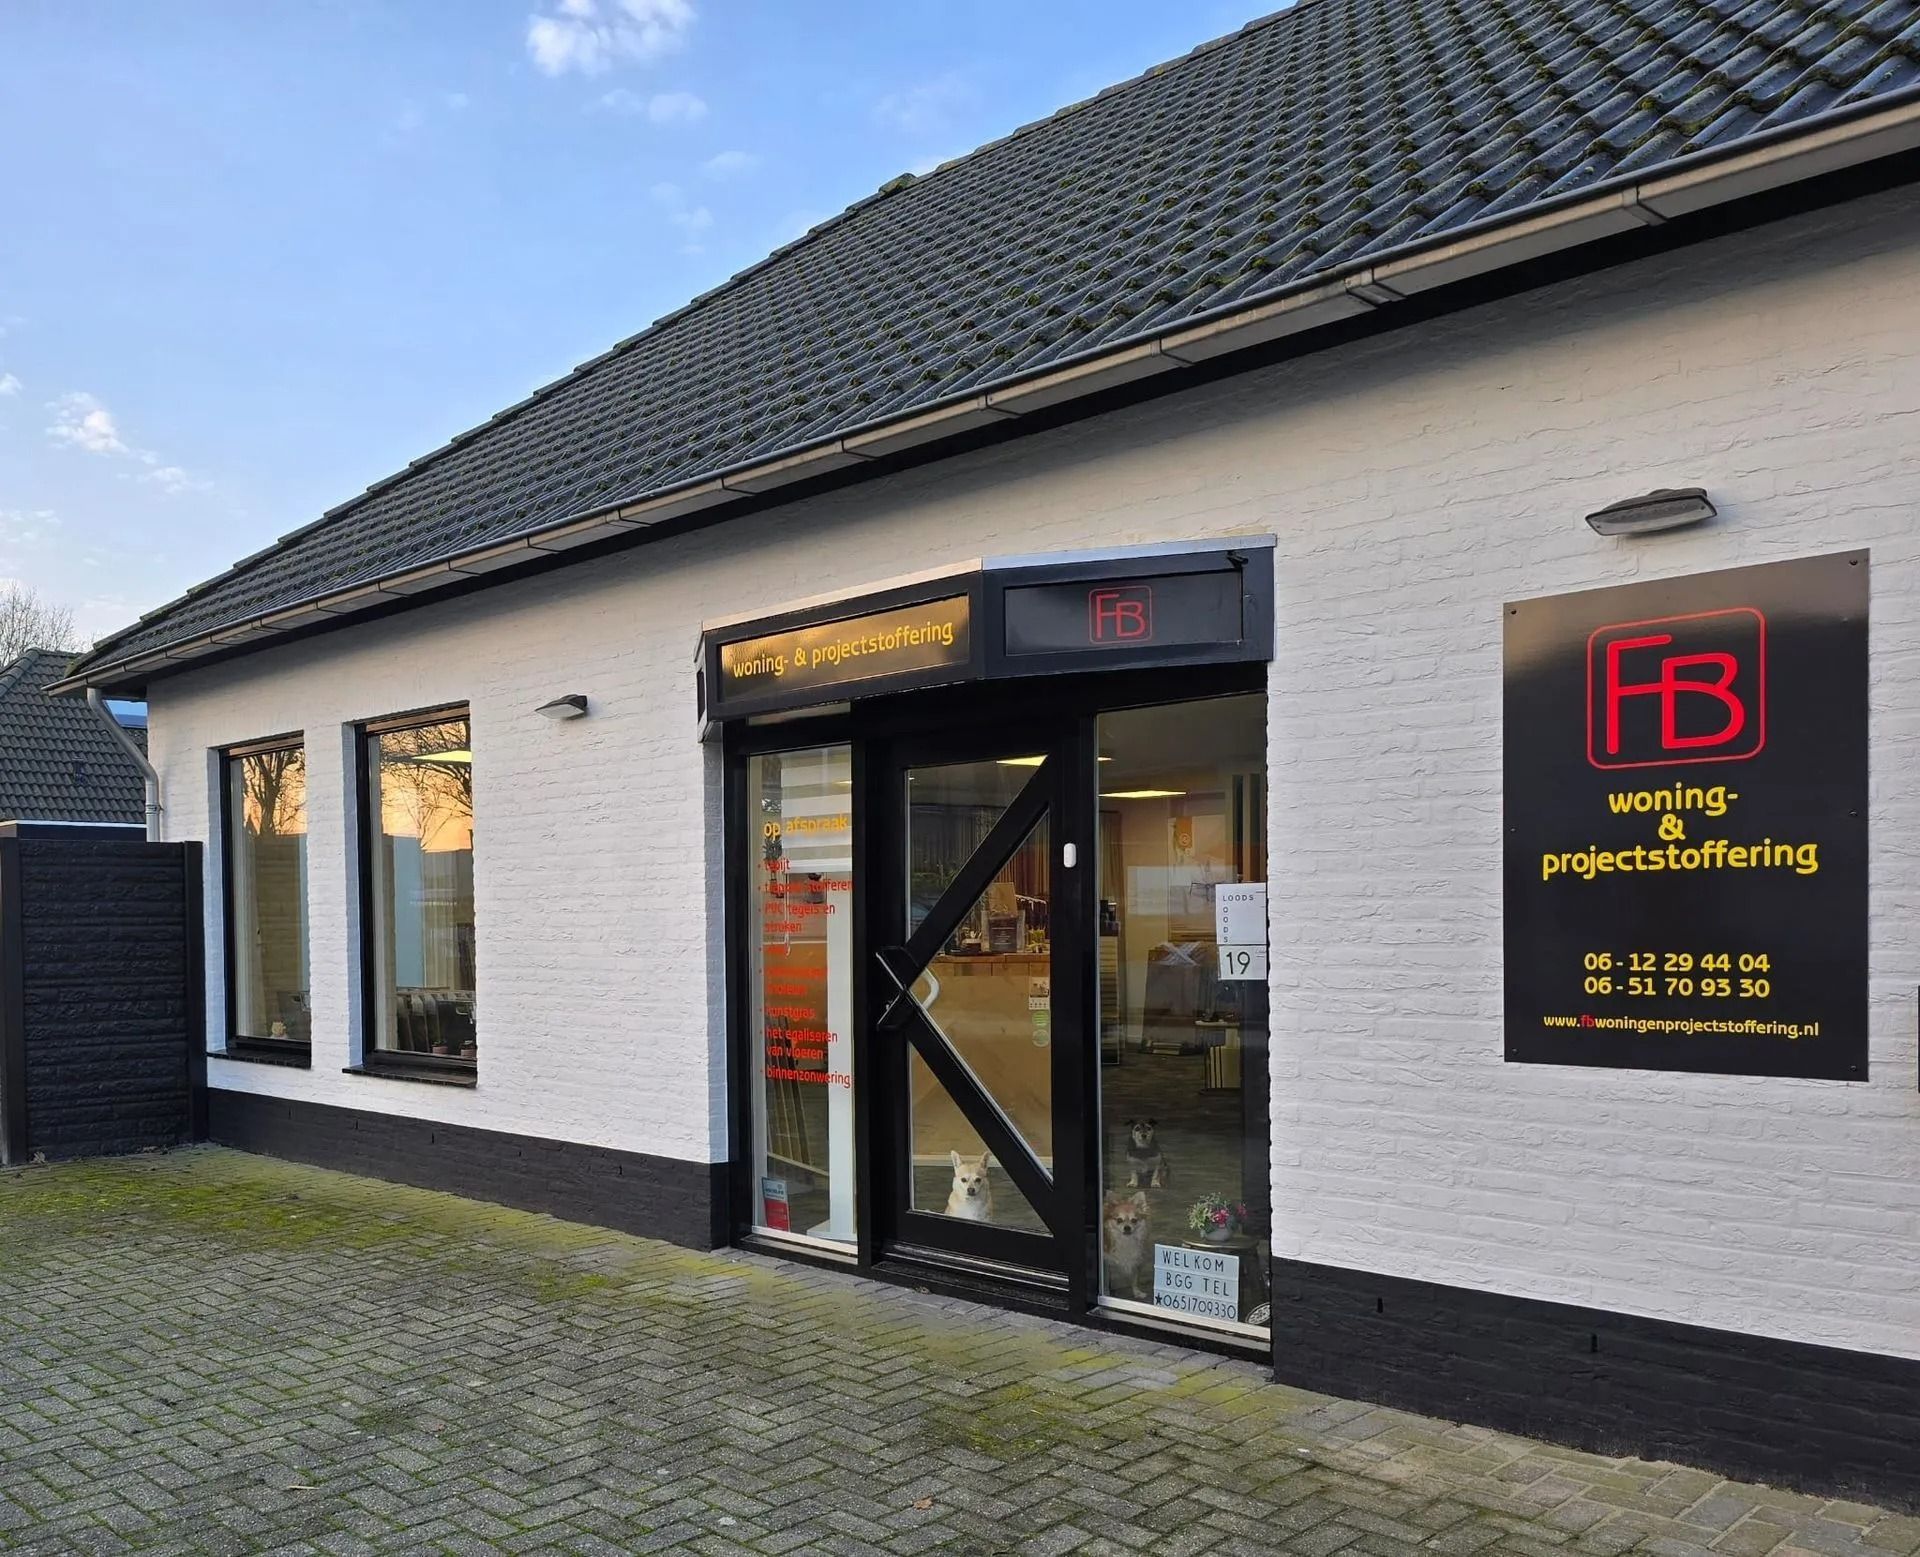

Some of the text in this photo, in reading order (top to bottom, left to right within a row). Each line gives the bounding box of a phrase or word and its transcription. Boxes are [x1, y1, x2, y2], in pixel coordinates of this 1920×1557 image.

[1096, 593, 1146, 639] FB
[733, 620, 953, 678] woning- & projectstoffering
[1607, 633, 1745, 754] FB
[1608, 782, 1738, 816] woning-
[1658, 813, 1685, 841] &
[1542, 838, 1819, 880] projectstoffering
[1223, 894, 1254, 902] LOODS
[1226, 951, 1250, 975] 19
[1584, 953, 1612, 971] 06
[1629, 953, 1656, 971] 12
[1664, 953, 1693, 972] 29
[1700, 954, 1731, 972] 44
[1738, 954, 1770, 972] 04
[1584, 976, 1612, 994] 06
[1628, 977, 1656, 995] 51
[1665, 978, 1693, 996] 70
[1700, 978, 1731, 997] 93
[1738, 979, 1770, 998] 30
[786, 1029, 838, 1046] egaliseren
[1543, 1014, 1819, 1039] www.fbwoningenprojectstoffering.nl
[767, 1045, 824, 1060] van vloeren
[767, 1065, 851, 1089] binnenzonwering
[1162, 1250, 1224, 1272] WELKOM
[1166, 1272, 1229, 1296] BGG TEL
[1163, 1294, 1236, 1319] 0651709330
